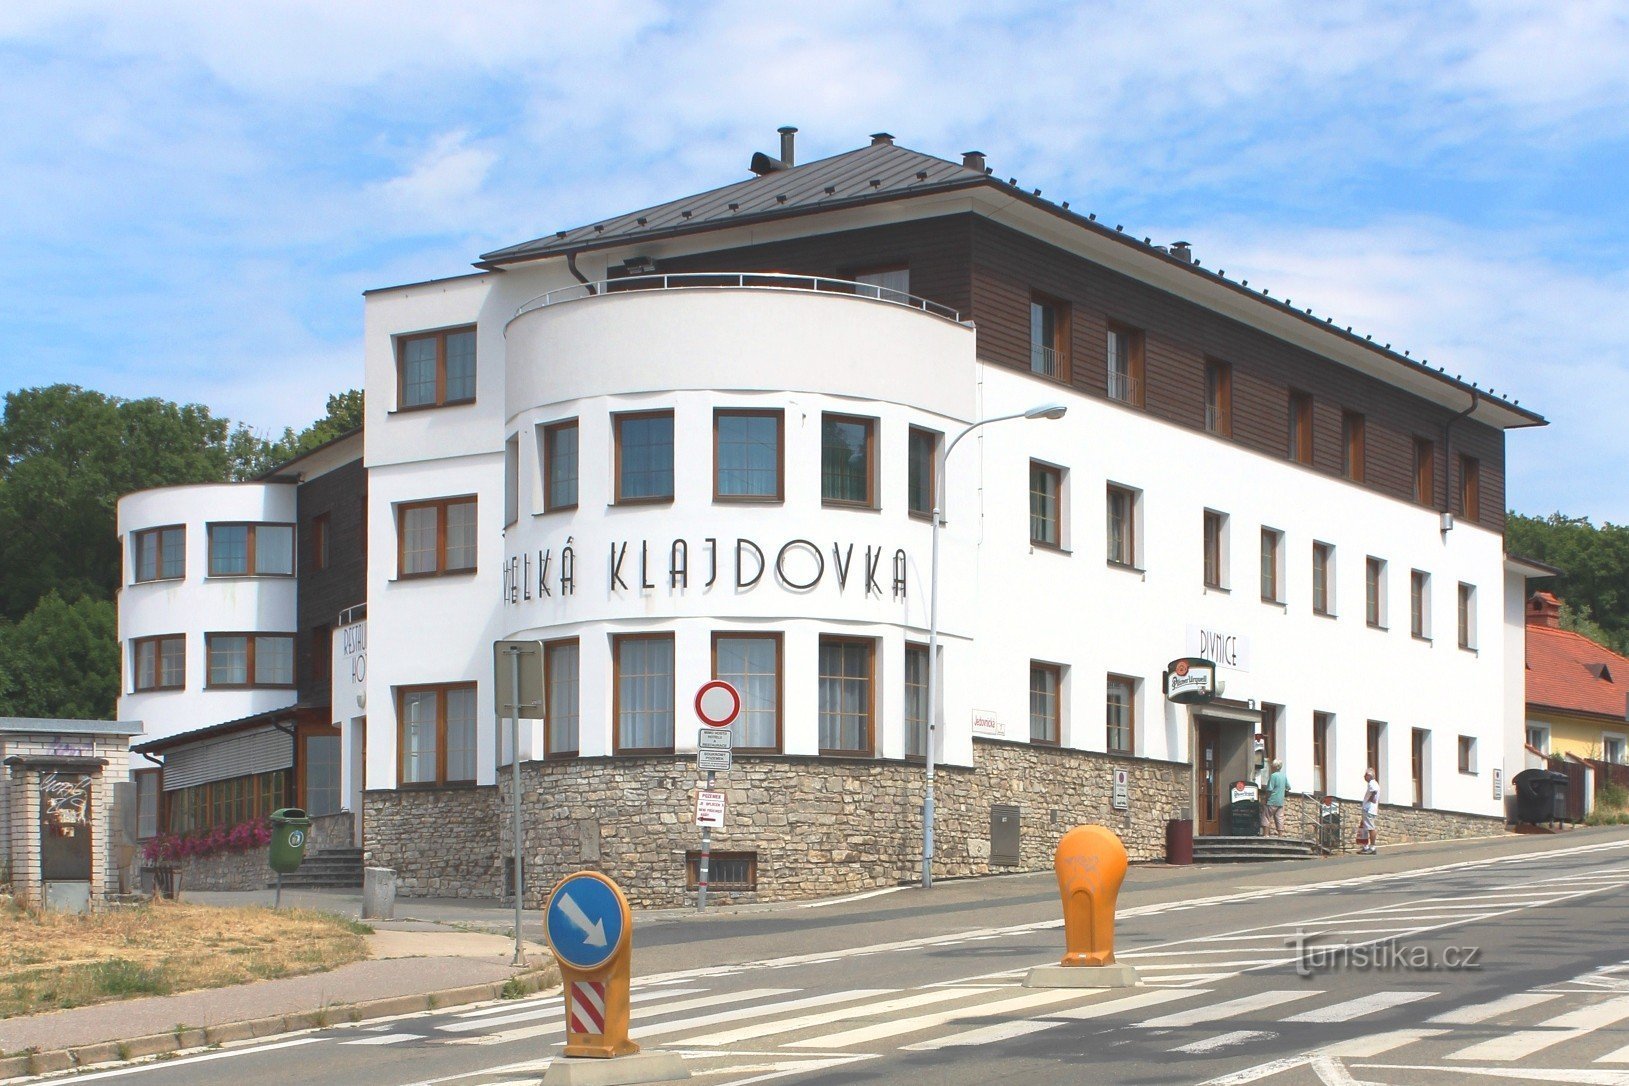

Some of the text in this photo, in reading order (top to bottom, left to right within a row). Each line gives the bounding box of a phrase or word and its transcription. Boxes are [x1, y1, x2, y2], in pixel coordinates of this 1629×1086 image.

[503, 536, 908, 605] VELKÁ KLAJDOVKA
[343, 623, 367, 655] RESTAU
[1200, 629, 1237, 666] PIVNICE
